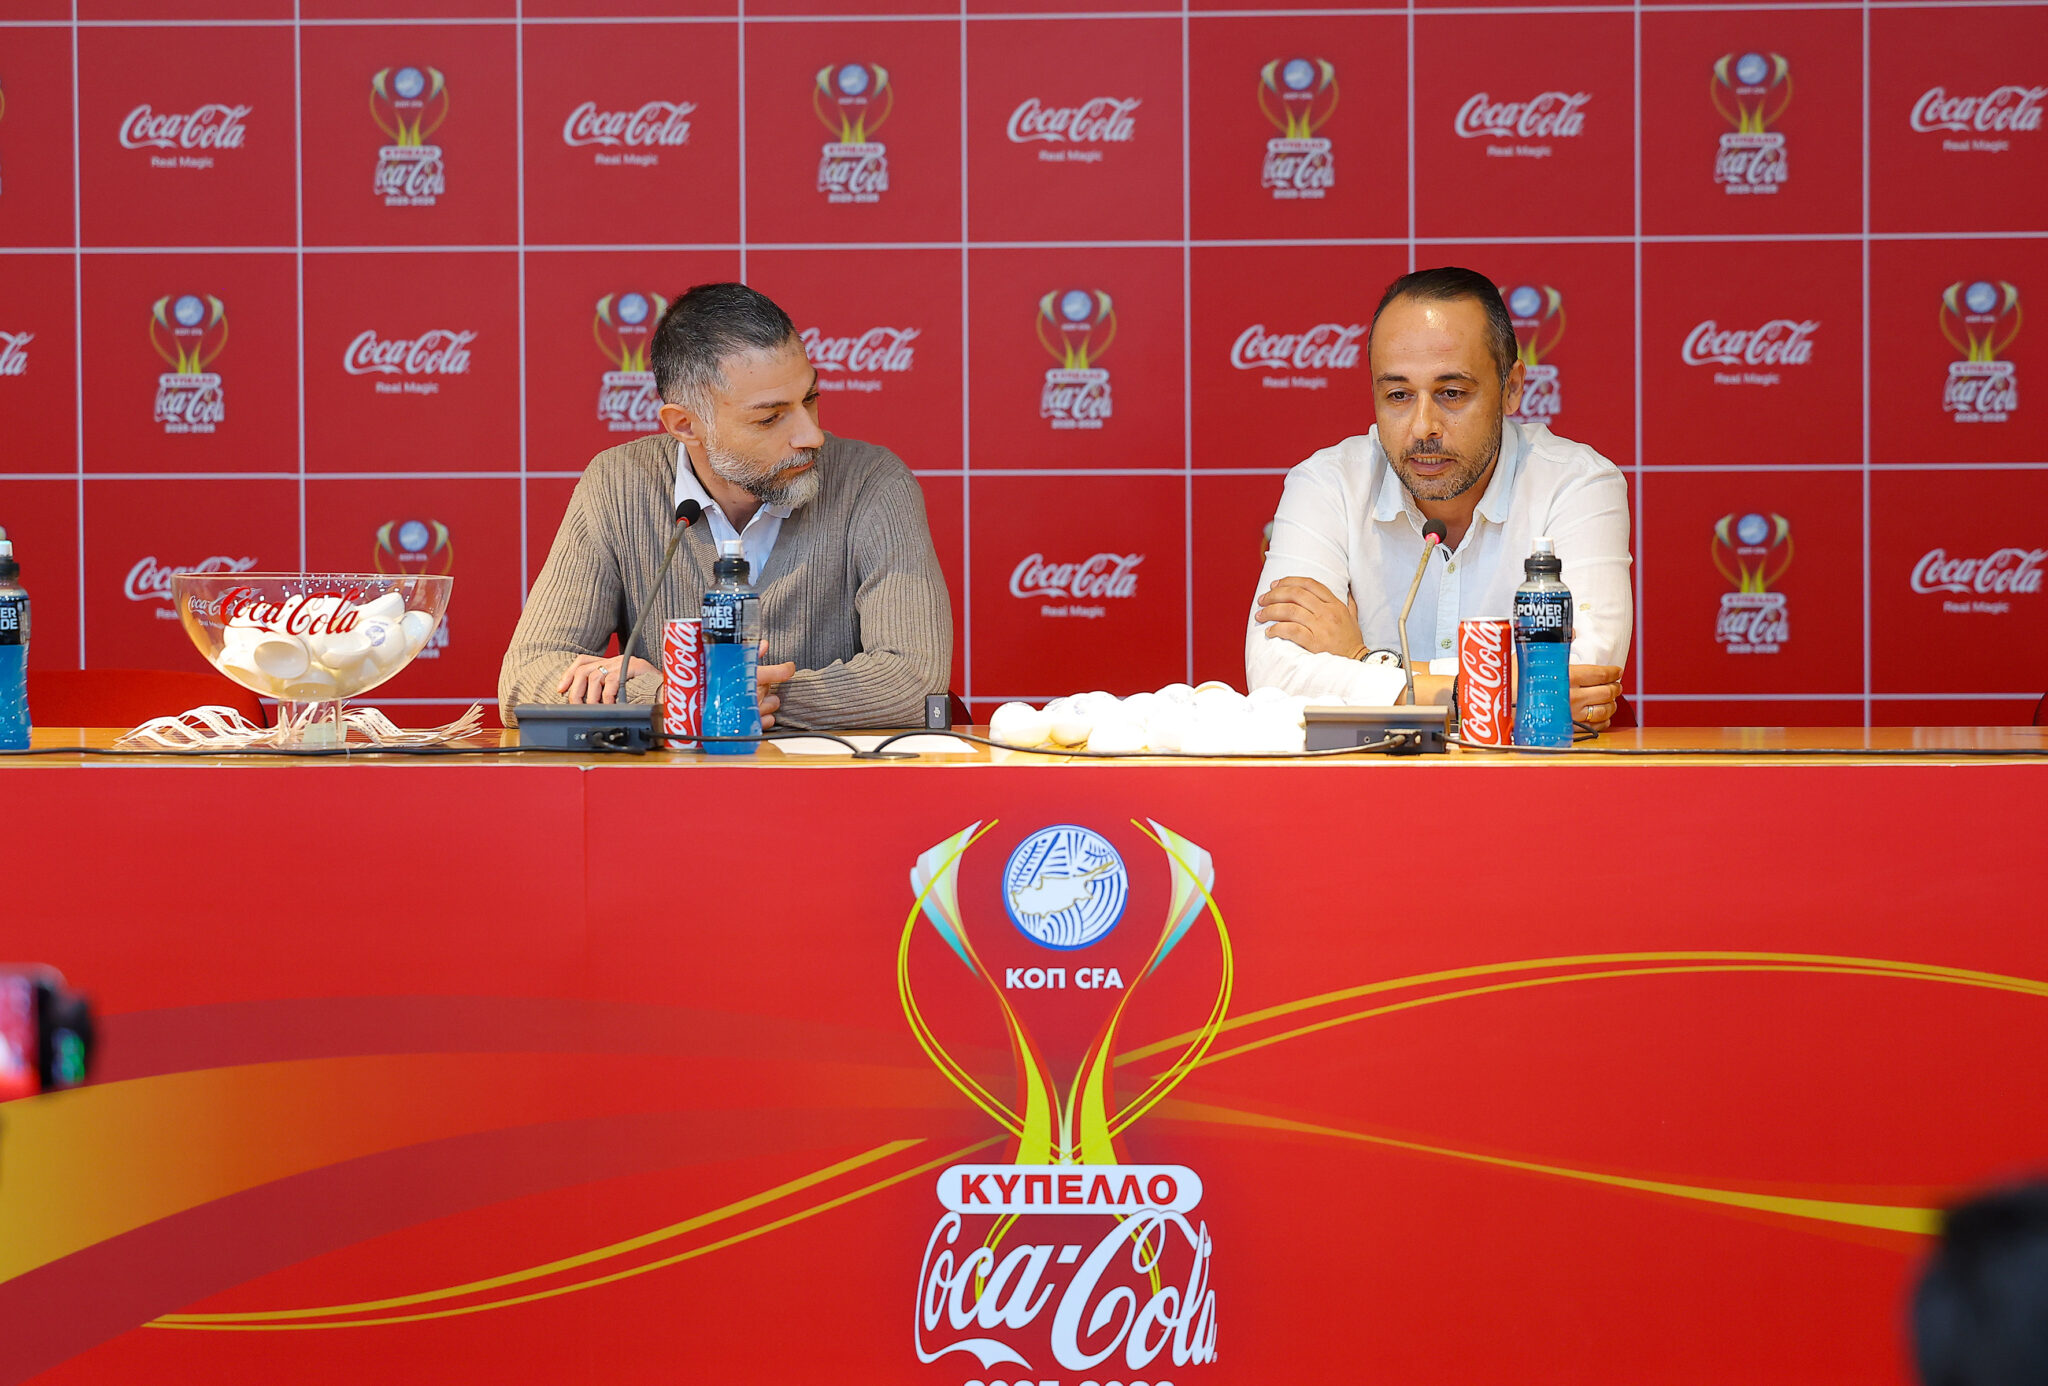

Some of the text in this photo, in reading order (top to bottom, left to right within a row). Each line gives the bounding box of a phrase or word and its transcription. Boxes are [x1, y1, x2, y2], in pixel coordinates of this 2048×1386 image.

[119, 104, 253, 149] Coca-Cola
[563, 101, 697, 147] Coca-Cola
[1007, 97, 1141, 143] Coca-Cola
[1454, 92, 1591, 138] Coca-Cola
[1911, 86, 2048, 132] Coca-Cola
[343, 330, 477, 375] Coca-Cola
[1231, 324, 1366, 370] Coca-Cola
[1682, 319, 1821, 366] Coca-Cola
[1009, 553, 1145, 599] Coca-Cola
[1911, 548, 2048, 593] Coca-Cola
[220, 587, 366, 636] Coca-Cola
[1517, 603, 1562, 616] POWER
[1005, 967, 1125, 989] ΚΟΠ CFA
[961, 1174, 1178, 1206] ΚΥΠΕΛΛΟ
[914, 1208, 1218, 1372] Coca-Cola
